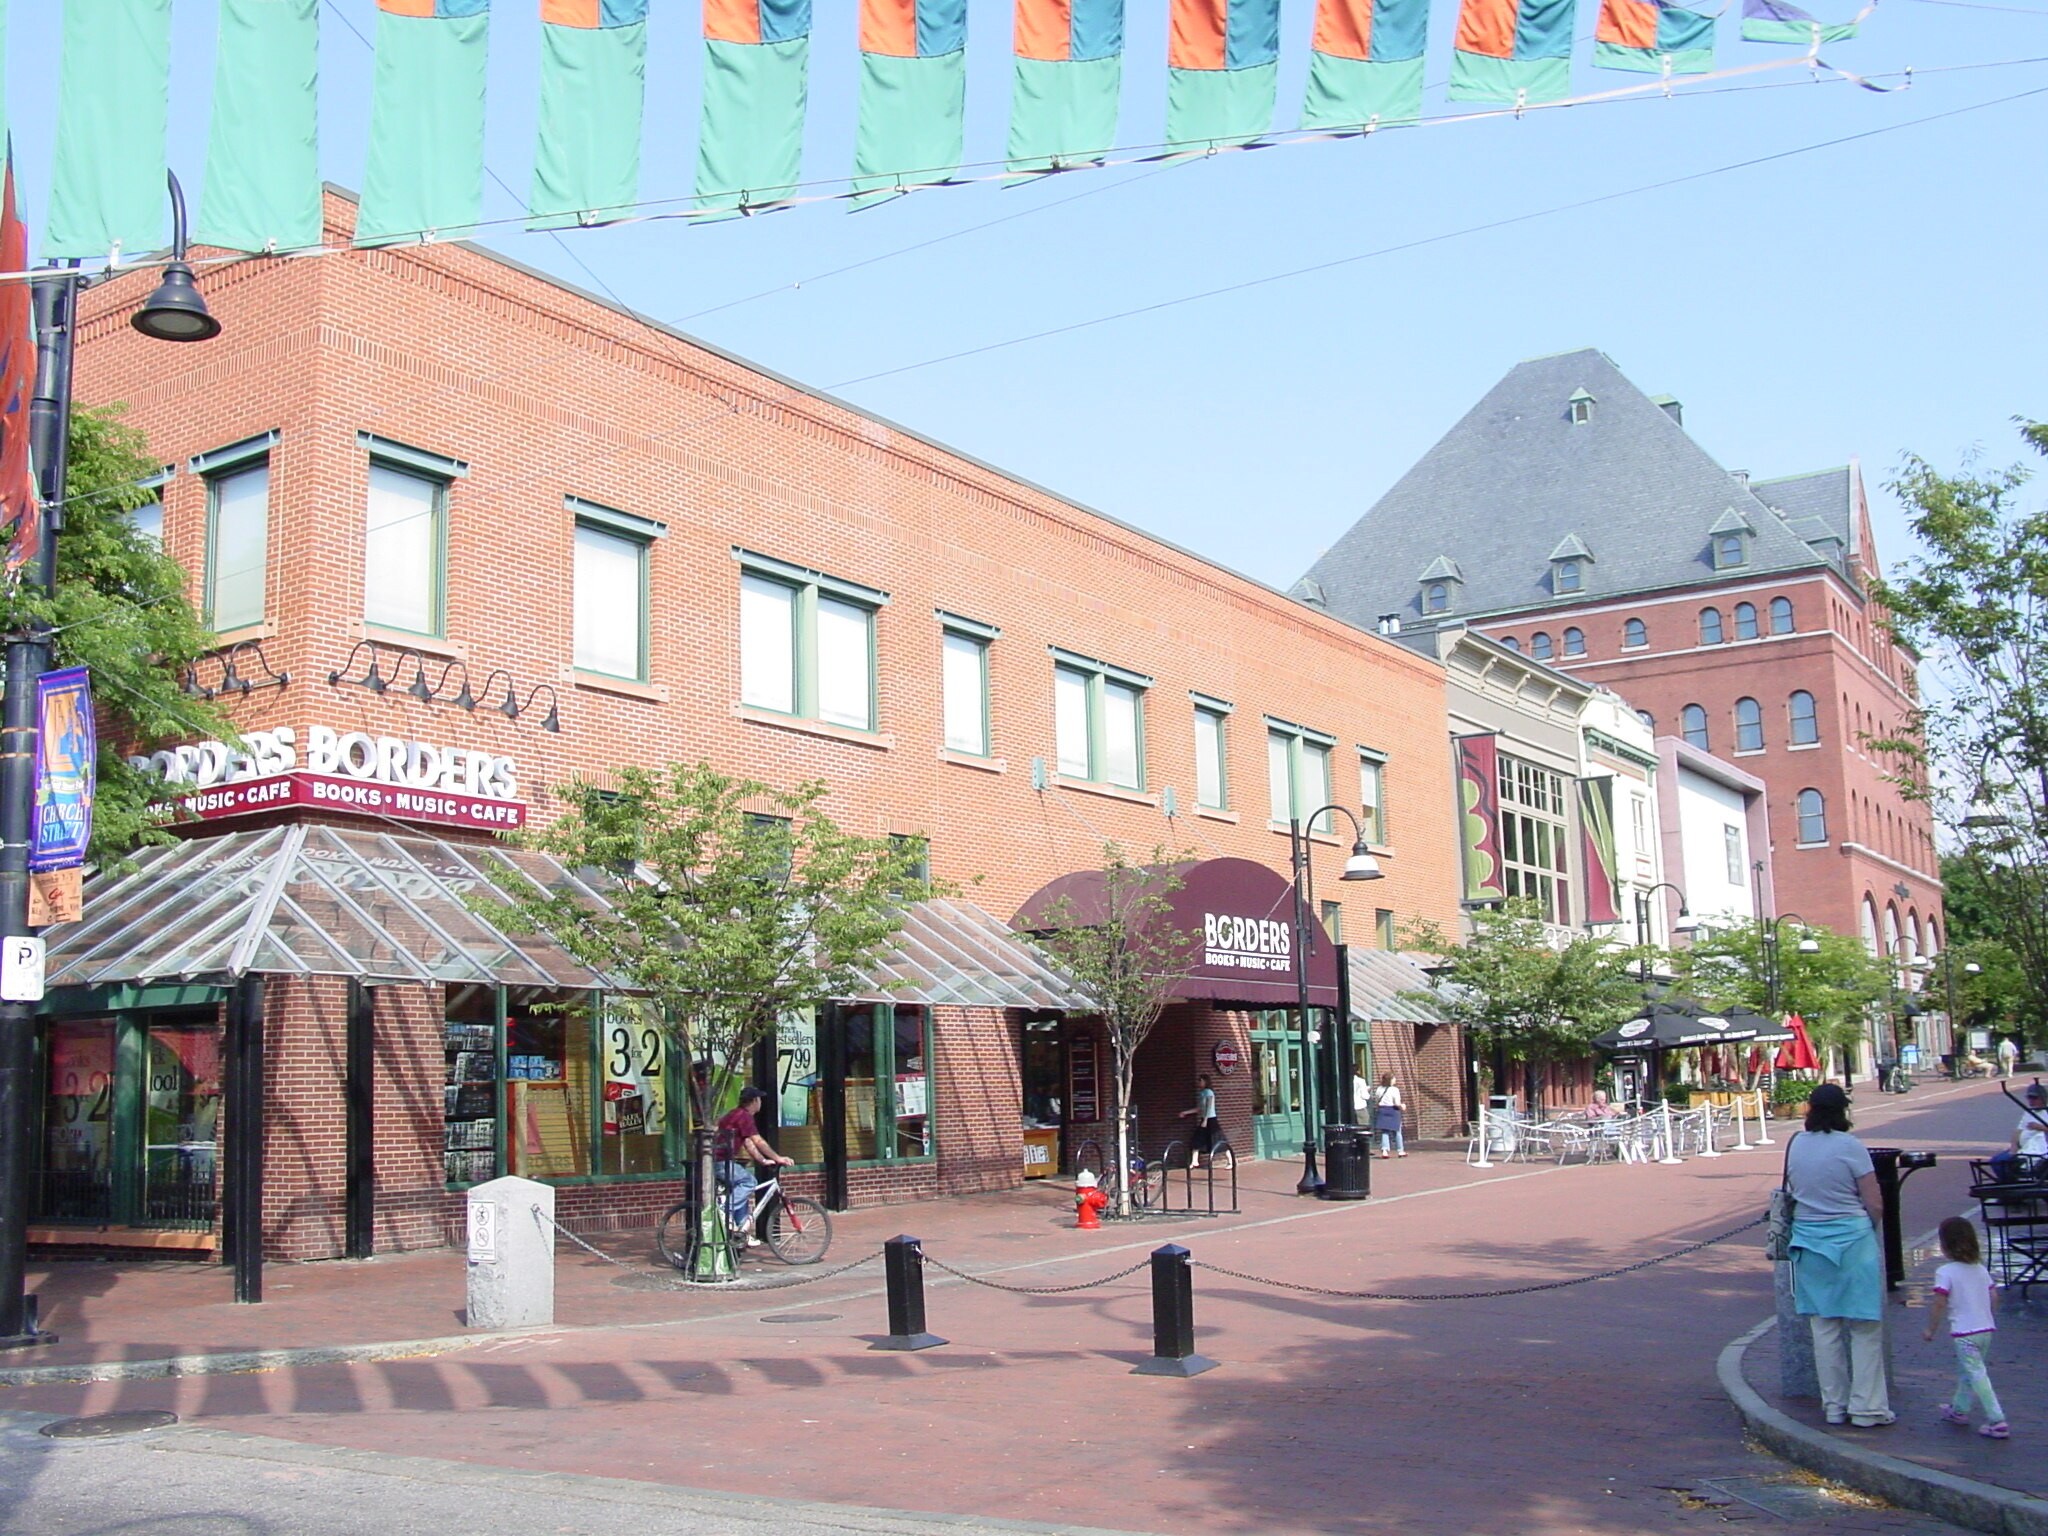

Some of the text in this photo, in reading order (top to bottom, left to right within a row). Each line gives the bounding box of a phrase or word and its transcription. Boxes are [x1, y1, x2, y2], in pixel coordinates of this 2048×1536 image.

[306, 725, 518, 799] BORDERS
[184, 790, 235, 814] MUSIC
[246, 781, 291, 803] CAFE
[312, 781, 518, 824] BOOKS MUSIC CAFE
[1205, 912, 1290, 955] BORDERS
[1205, 952, 1290, 971] BOOKS MUSIC CAFE
[609, 1027, 632, 1078] 3
[640, 1028, 662, 1078] 2
